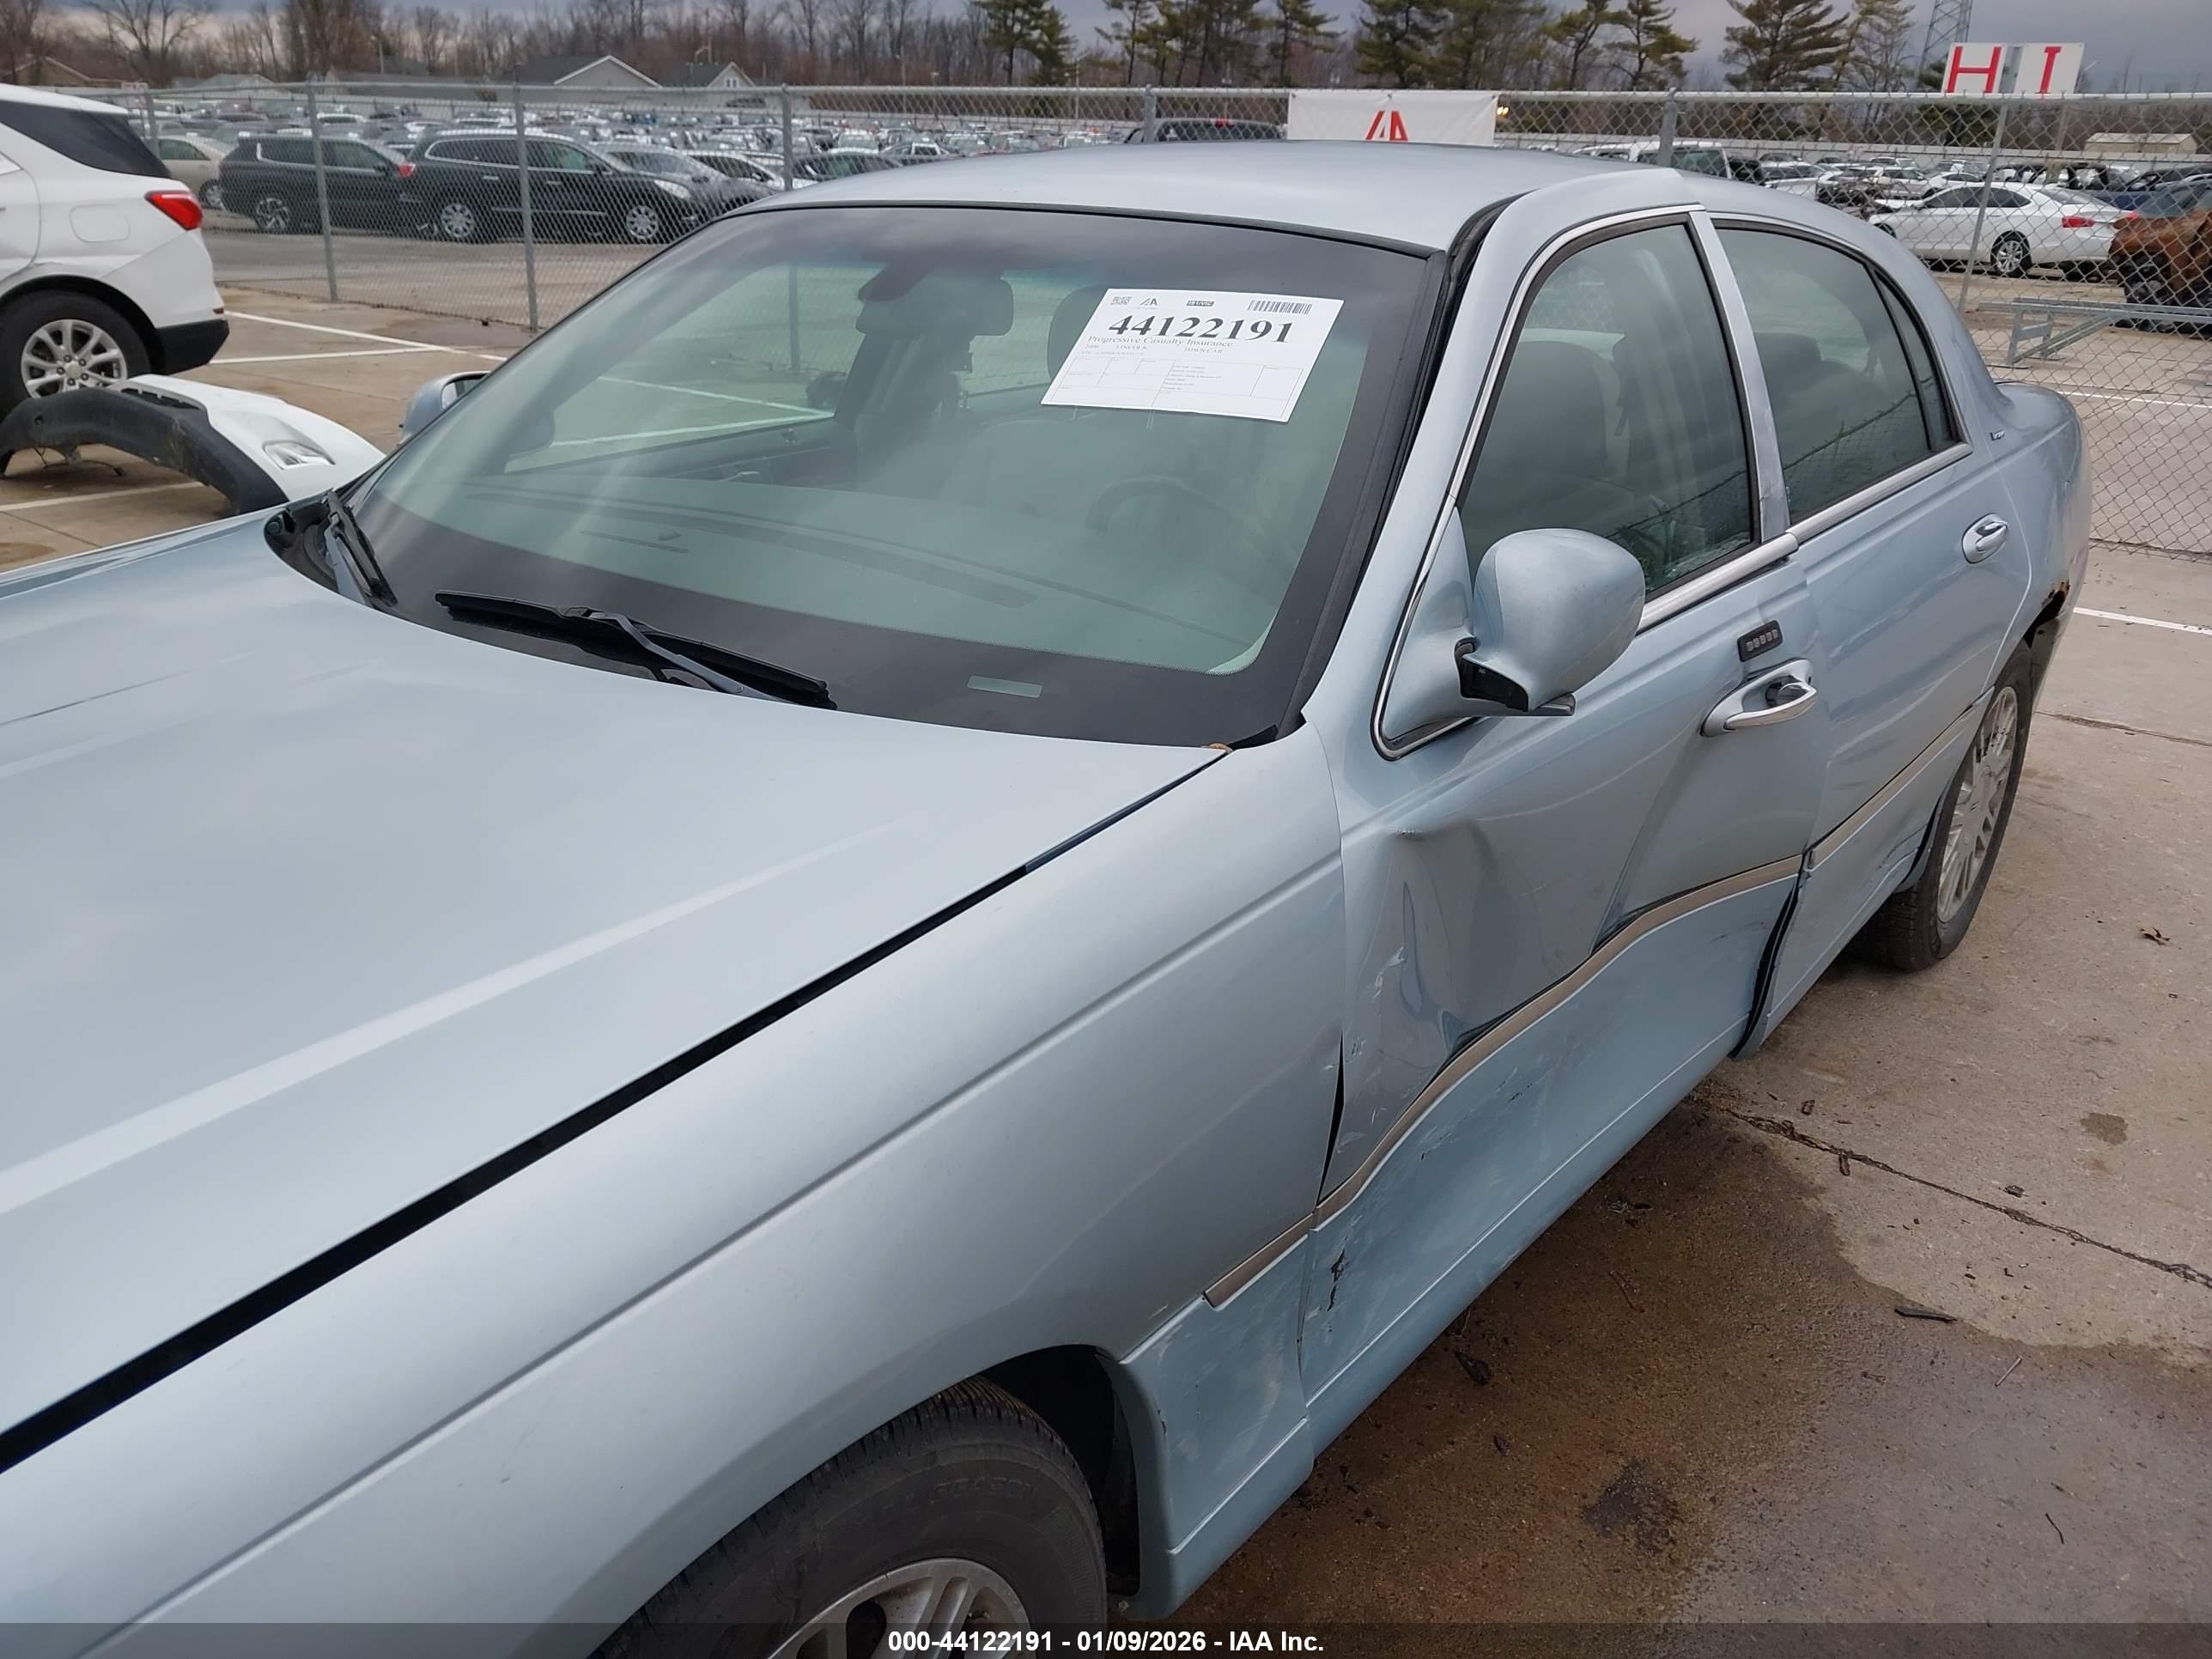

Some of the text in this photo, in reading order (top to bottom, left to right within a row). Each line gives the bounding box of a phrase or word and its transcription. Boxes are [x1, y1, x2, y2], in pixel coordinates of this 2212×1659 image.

[1109, 315, 1293, 343] 44122191
[1087, 336, 1233, 349] Progressive Casualty Insurance
